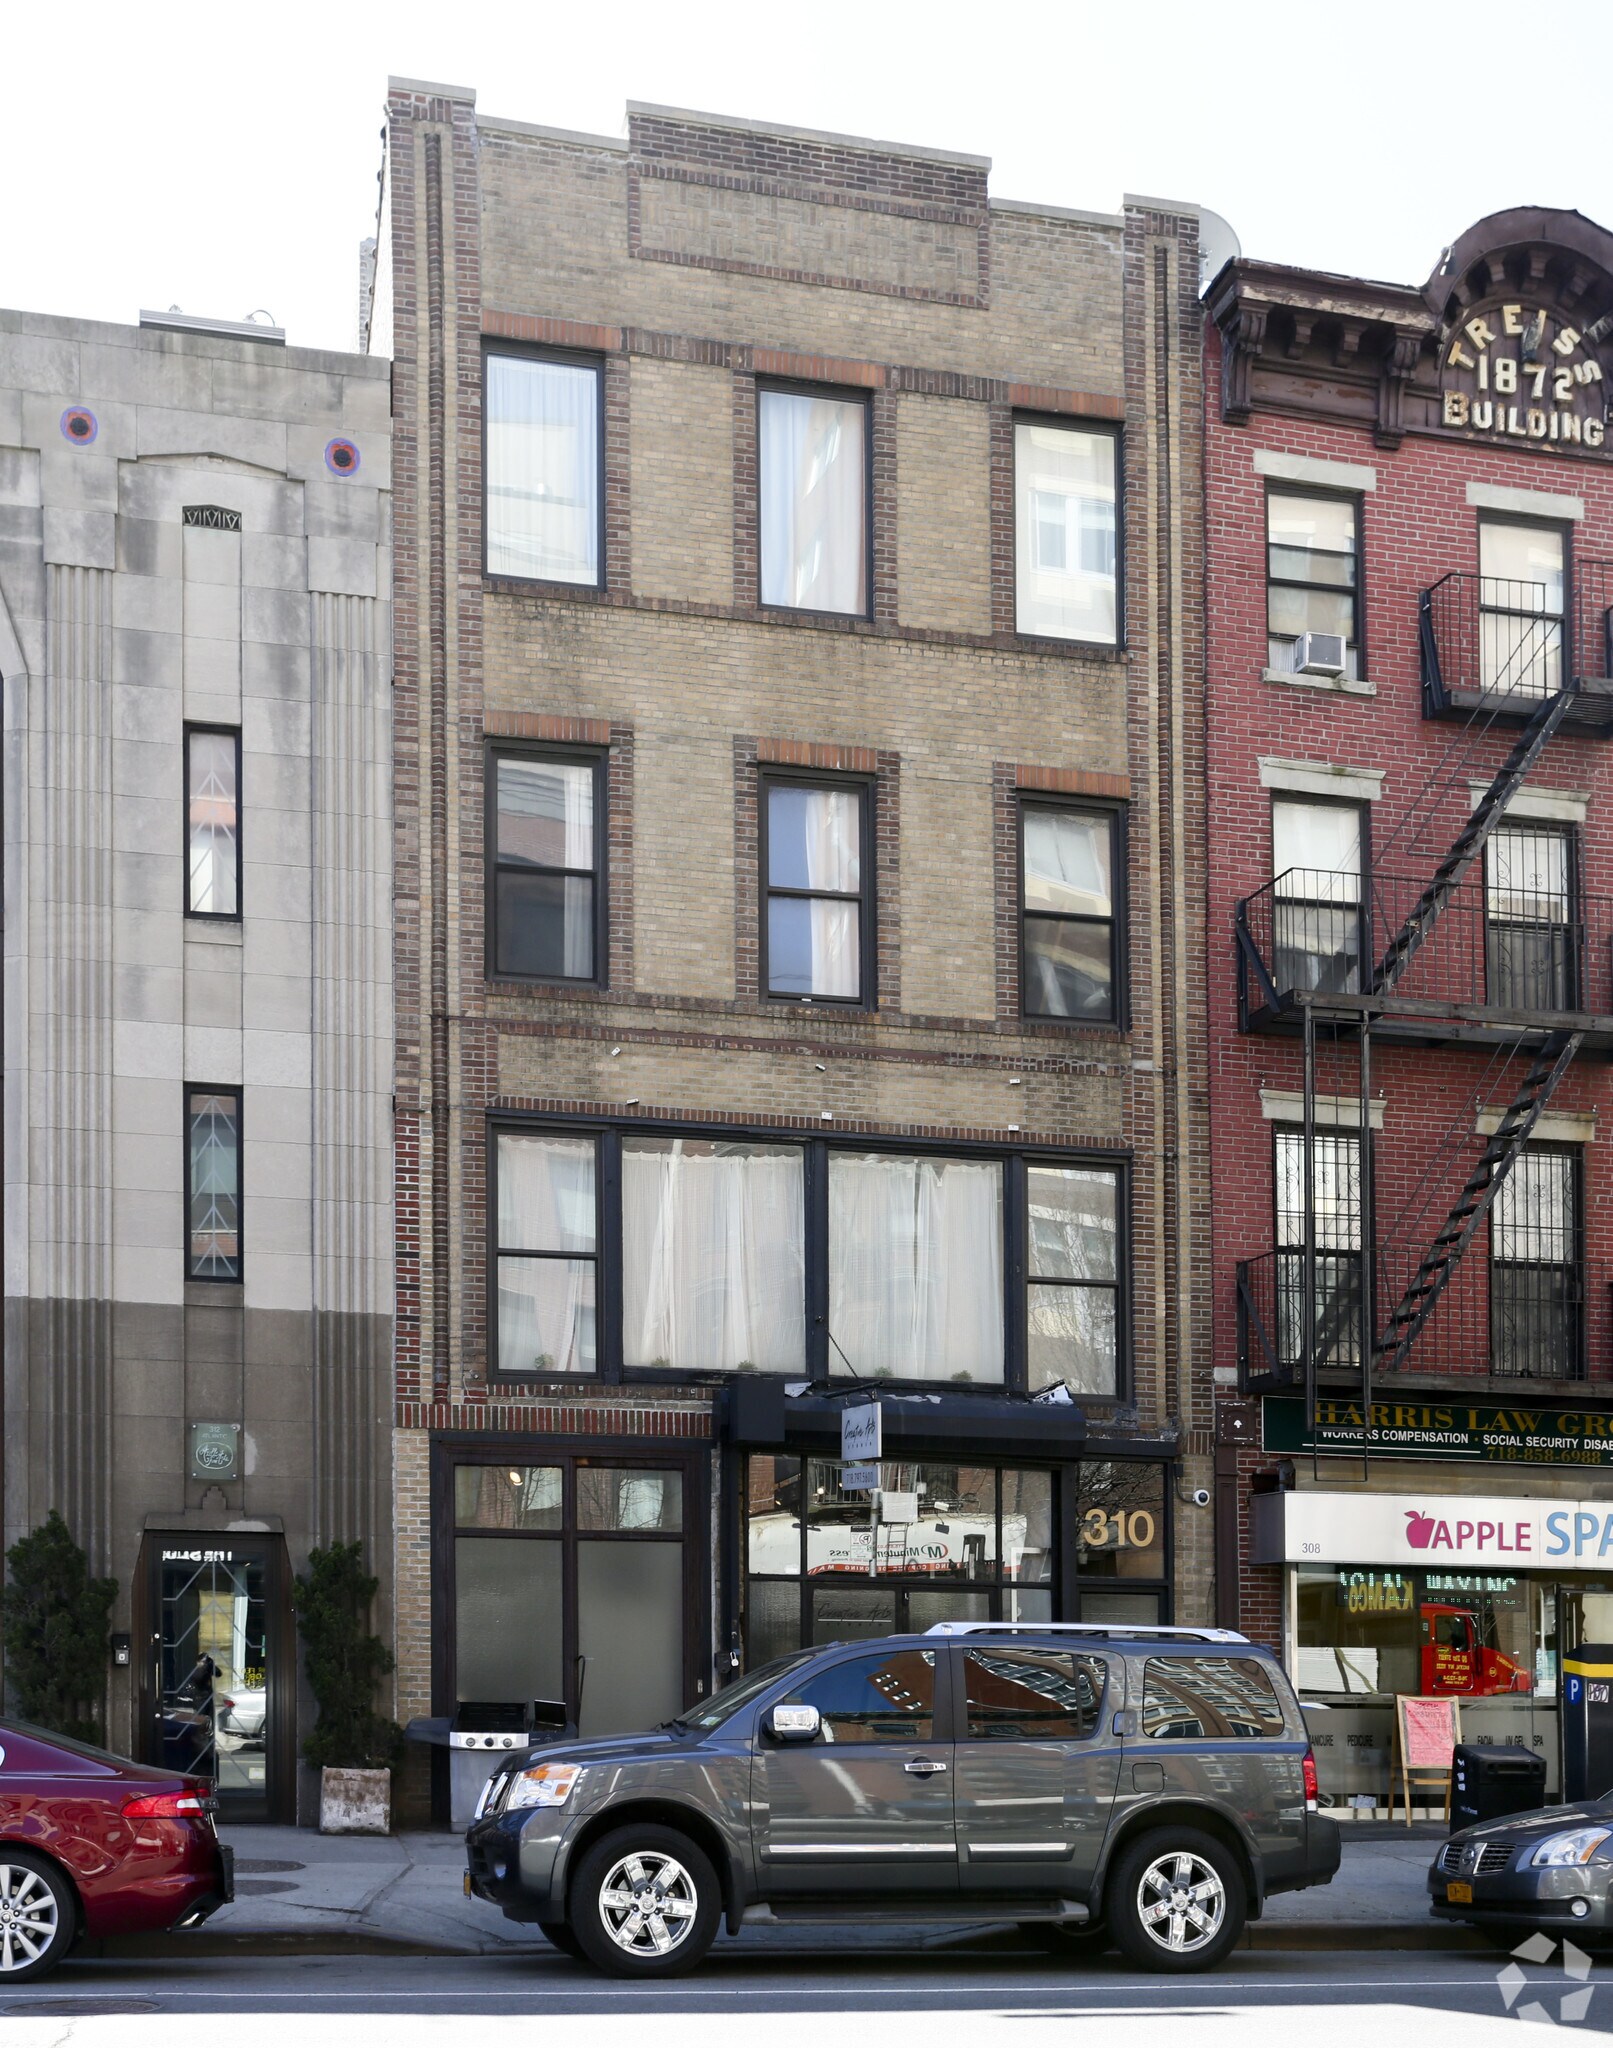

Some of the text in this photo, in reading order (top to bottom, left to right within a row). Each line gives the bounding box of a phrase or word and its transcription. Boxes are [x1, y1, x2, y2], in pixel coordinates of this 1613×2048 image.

[1478, 353, 1574, 401] 1872
[1443, 389, 1604, 447] BUILDING
[1315, 1402, 1613, 1437] HARRIS LAW GR
[1382, 1429, 1469, 1444] COMPENSATION
[1483, 1434, 1524, 1446] SOCIAL
[1525, 1436, 1579, 1449] SECURITY
[1486, 1446, 1601, 1465] 718-858-6988
[1083, 1508, 1155, 1548] 310
[1431, 1520, 1532, 1551] APPLE
[1302, 1542, 1321, 1554] 308
[1347, 1734, 1374, 1747] PEDICURE
[1533, 1735, 1544, 1747] SPA
